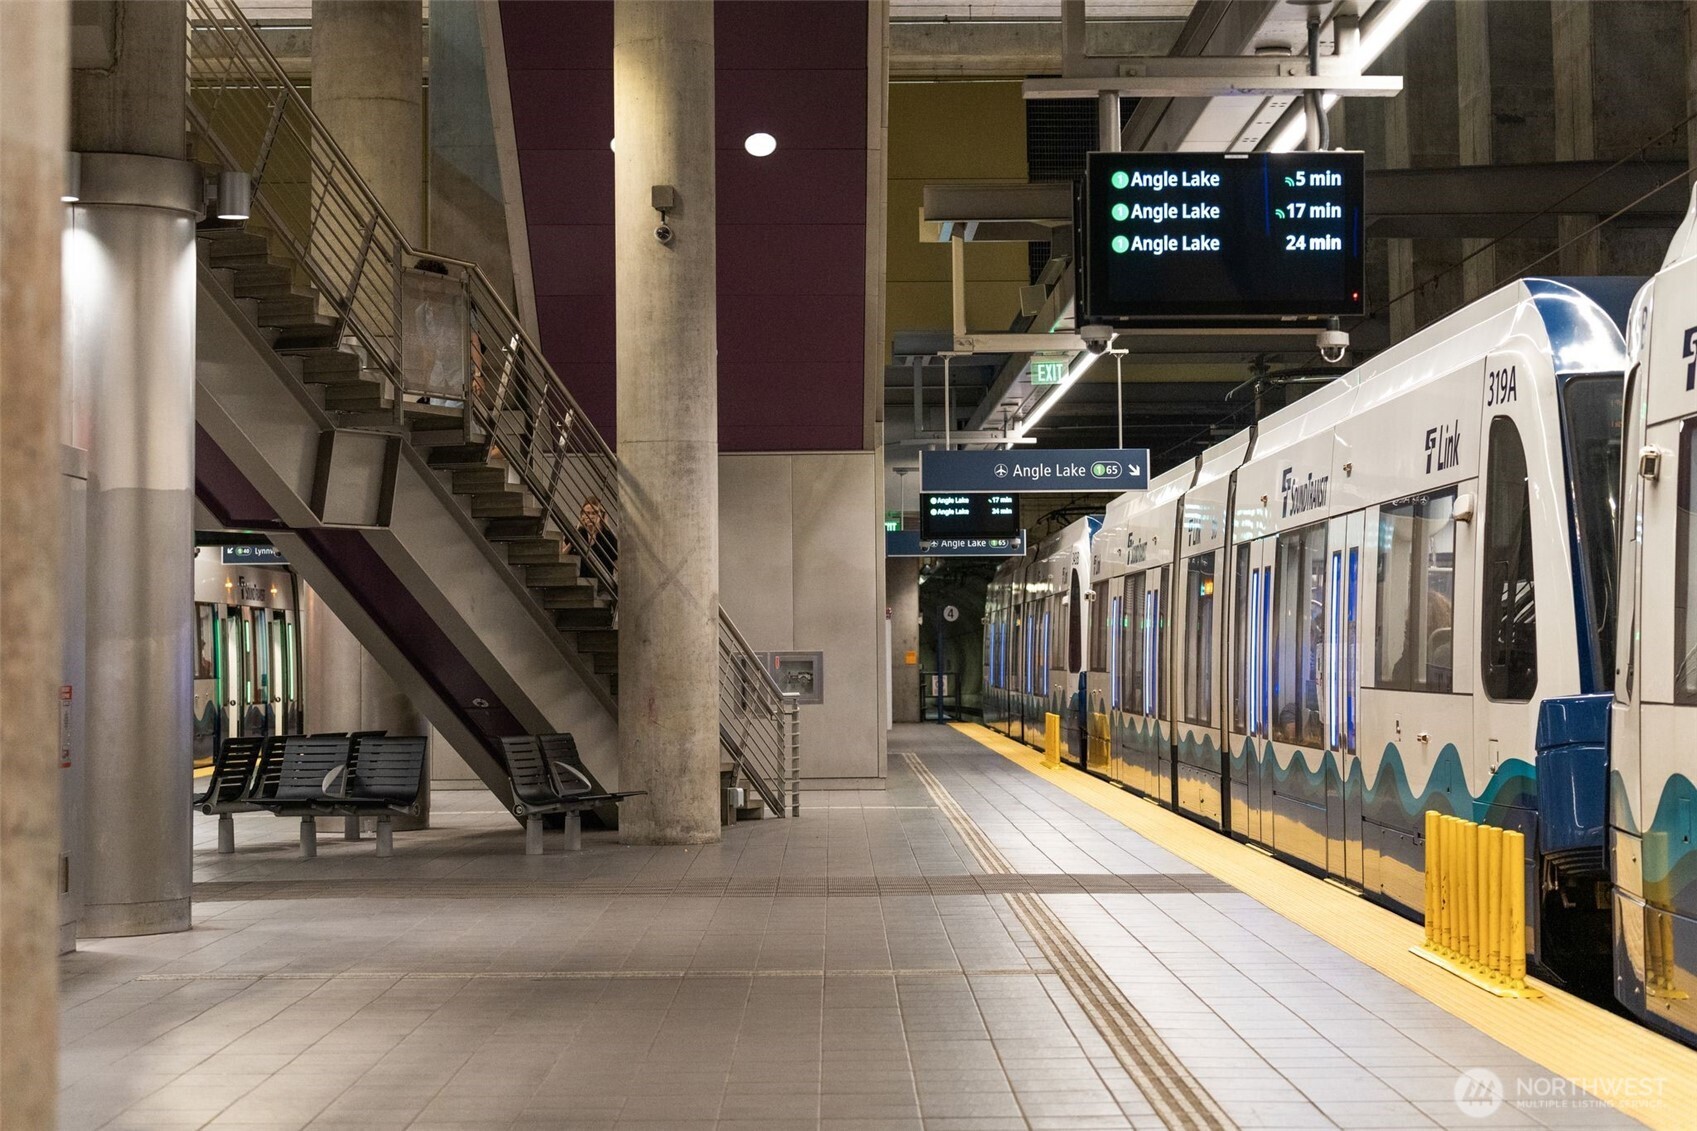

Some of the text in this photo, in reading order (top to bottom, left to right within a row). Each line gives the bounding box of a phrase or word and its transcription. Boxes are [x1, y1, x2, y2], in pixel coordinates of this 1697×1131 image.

[1130, 170, 1179, 191] Angle
[1182, 170, 1220, 187] Lake
[1295, 170, 1306, 187] 5
[1309, 169, 1342, 187] min
[1130, 202, 1179, 223] Angle
[1182, 202, 1220, 219] Lake
[1286, 202, 1307, 219] 17
[1309, 201, 1342, 219] min
[1130, 234, 1179, 255] Angle
[1182, 234, 1220, 251] Lake
[1285, 234, 1307, 251] 24
[1309, 233, 1342, 251] min
[1037, 363, 1063, 382] EXIT
[1487, 365, 1517, 407] 319A
[1437, 419, 1461, 471] Link
[1012, 463, 1052, 480] Angle
[1056, 463, 1086, 477] Lake
[1105, 465, 1118, 475] 65
[937, 496, 954, 505] Angle
[955, 496, 970, 504] Lake
[937, 508, 954, 516] Angle
[940, 539, 966, 549] Angle
[967, 539, 987, 547] Lake
